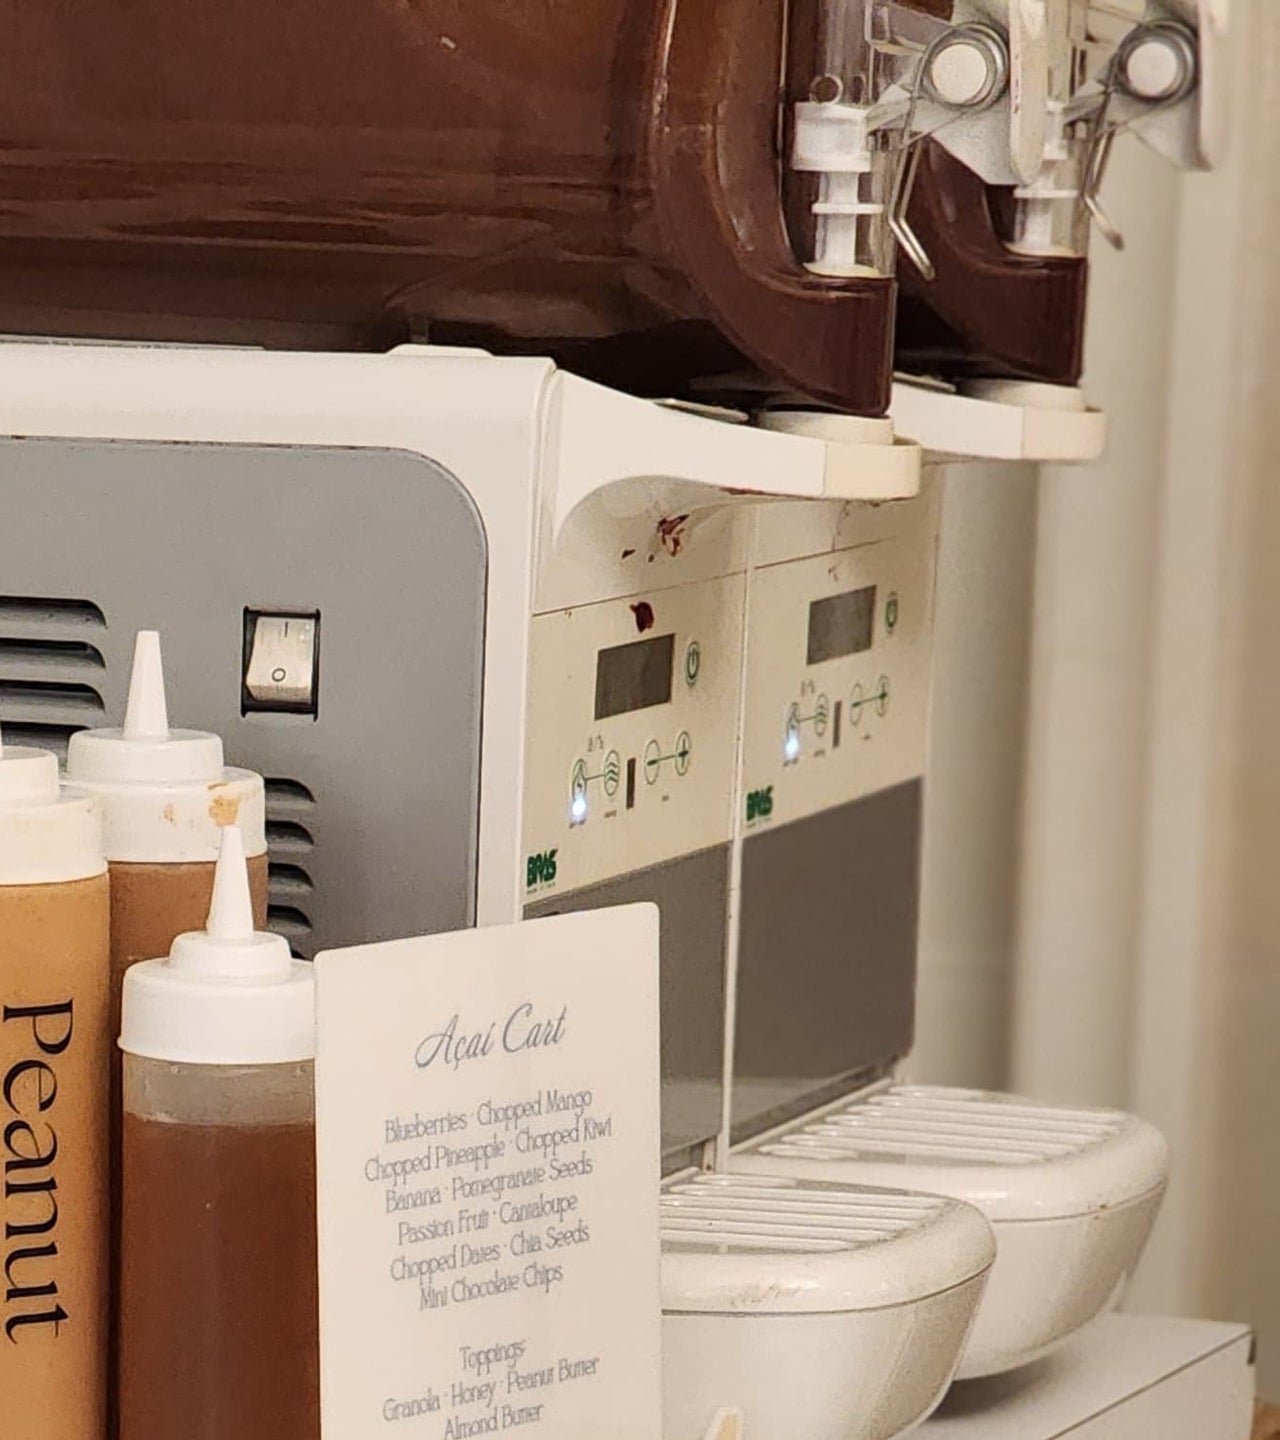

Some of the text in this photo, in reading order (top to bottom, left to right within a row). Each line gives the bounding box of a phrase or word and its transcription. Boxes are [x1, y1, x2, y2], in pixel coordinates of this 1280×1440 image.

[503, 1002, 567, 1053] Cart
[385, 1089, 593, 1145] Blueberries Chopped Mango
[3, 998, 74, 1344] Peanut
[364, 1116, 612, 1187] Chopped Pineapple Chopped Kiwi
[386, 1150, 593, 1214] Banana Pomegranate Seeds
[398, 1194, 578, 1246] Passion Fruit Cantaloupe
[390, 1219, 591, 1286] Chopped Dates Chia Seeds
[419, 1260, 563, 1311] Mini Chocolate Chips
[382, 1388, 440, 1422] Granola
[451, 1378, 496, 1408] Honey
[507, 1369, 553, 1394] Peanut
